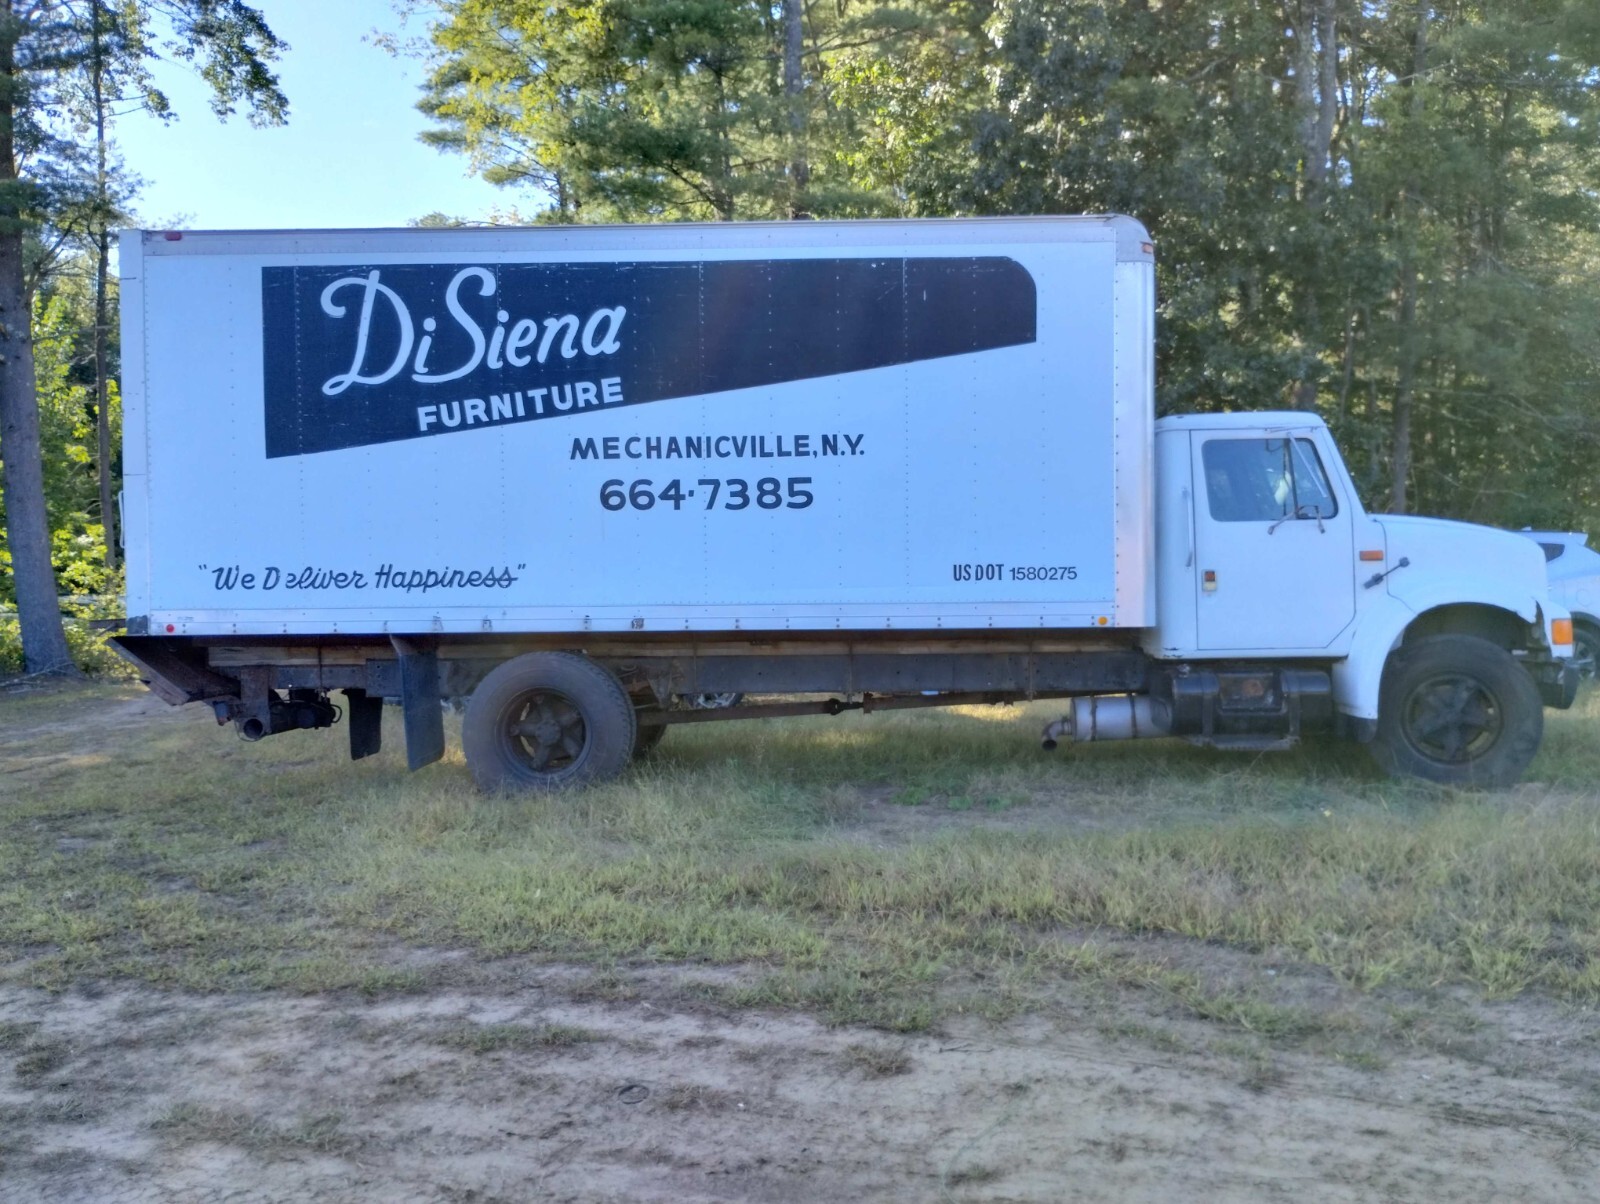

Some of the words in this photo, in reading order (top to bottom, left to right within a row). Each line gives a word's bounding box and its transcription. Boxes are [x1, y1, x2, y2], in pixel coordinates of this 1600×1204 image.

[320, 266, 627, 396] DiSiena
[417, 376, 624, 431] FURNITURE
[262, 565, 368, 590] Deliver
[375, 563, 526, 594] Happiness"
[1009, 566, 1078, 581] 1580275
